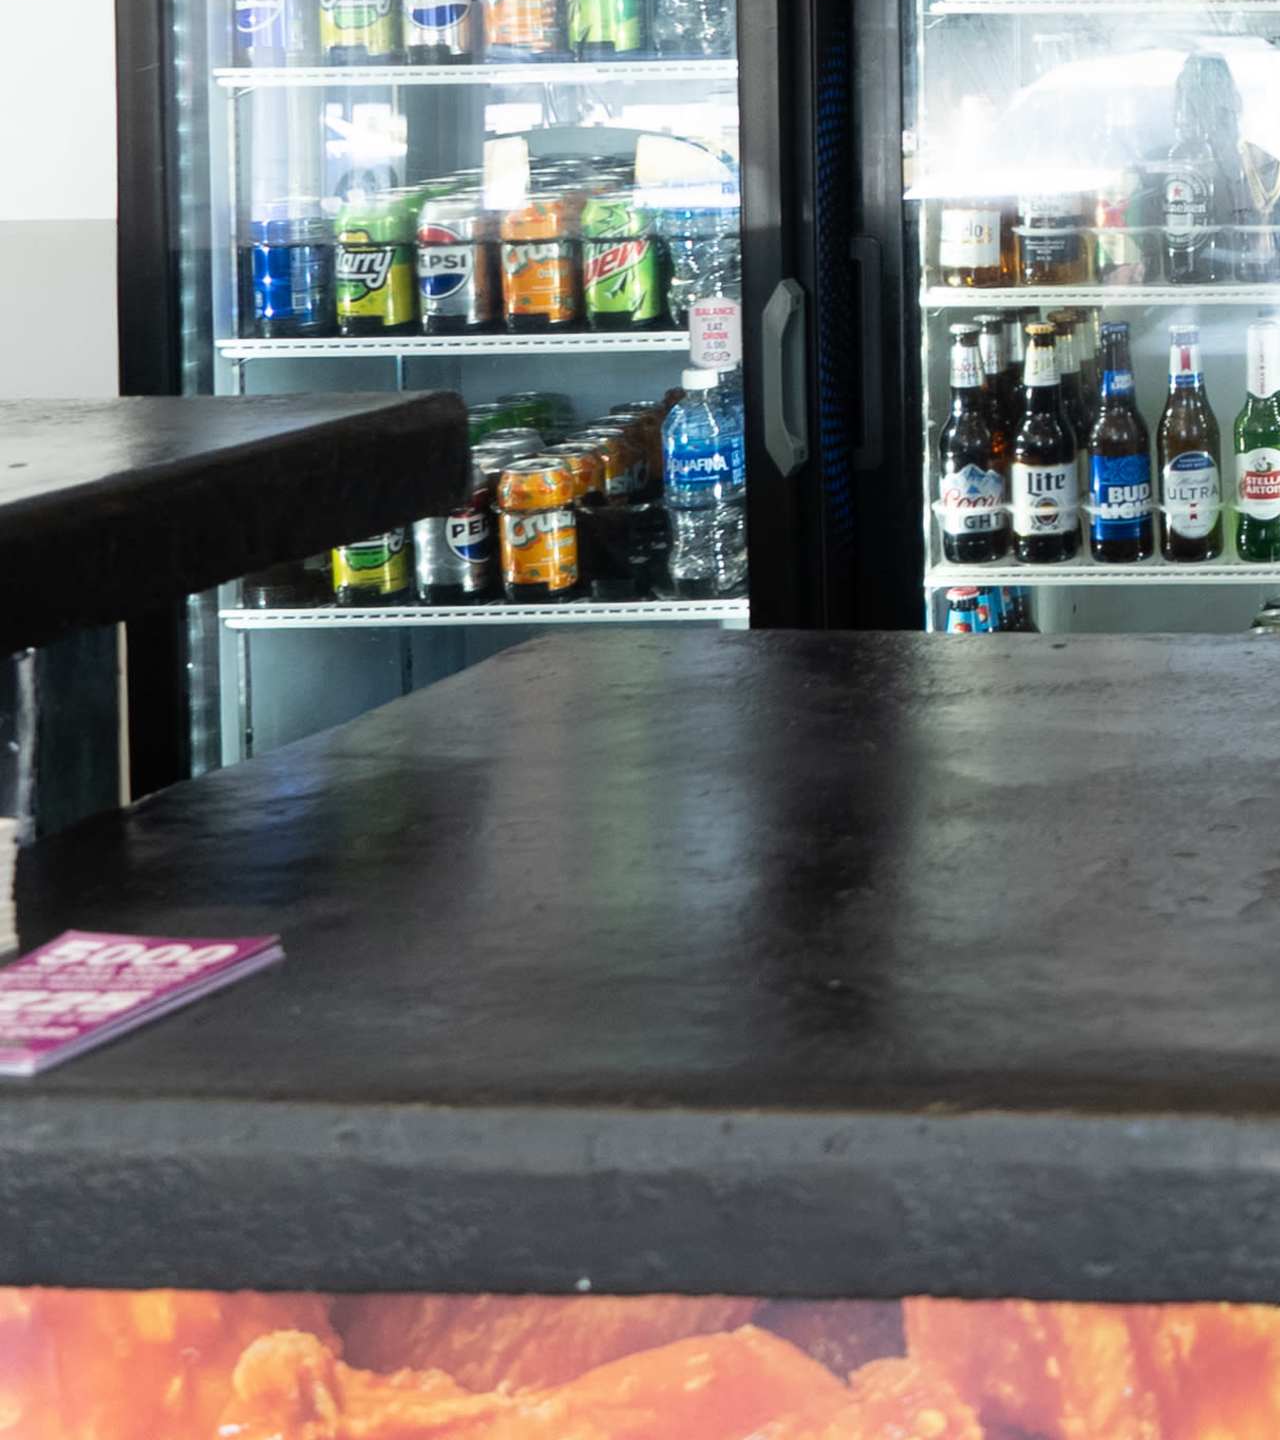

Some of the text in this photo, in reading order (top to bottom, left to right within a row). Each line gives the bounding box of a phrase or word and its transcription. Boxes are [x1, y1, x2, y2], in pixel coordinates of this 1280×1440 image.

[1026, 471, 1066, 497] Lite
[1108, 485, 1150, 501] BUD
[1167, 486, 1219, 501] ULTRA
